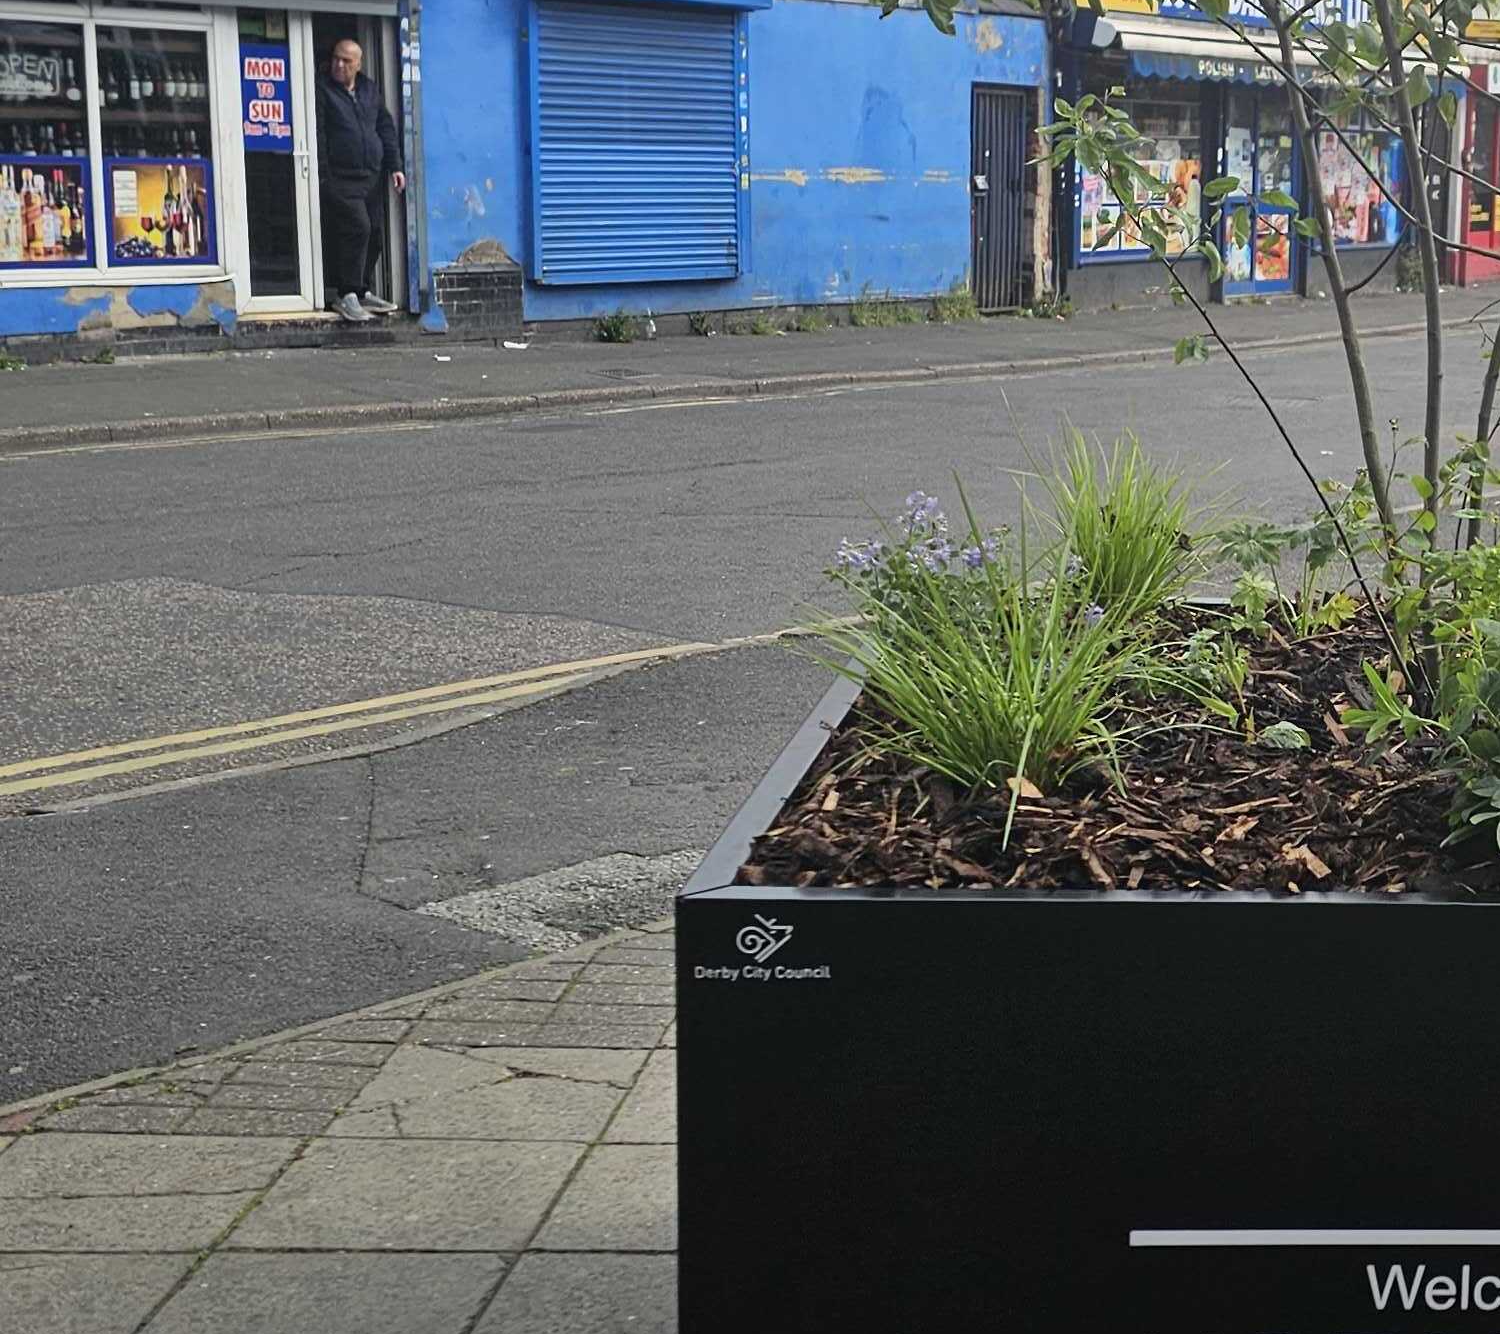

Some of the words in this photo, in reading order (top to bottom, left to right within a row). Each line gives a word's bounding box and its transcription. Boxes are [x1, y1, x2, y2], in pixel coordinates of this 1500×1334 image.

[0, 53, 55, 80] OPEN
[246, 58, 284, 78] MON
[1198, 59, 1234, 77] POLISH
[257, 82, 275, 98] TO
[250, 101, 283, 120] SUN
[694, 966, 740, 981] Derby
[742, 965, 772, 981] City
[774, 965, 831, 979] Council
